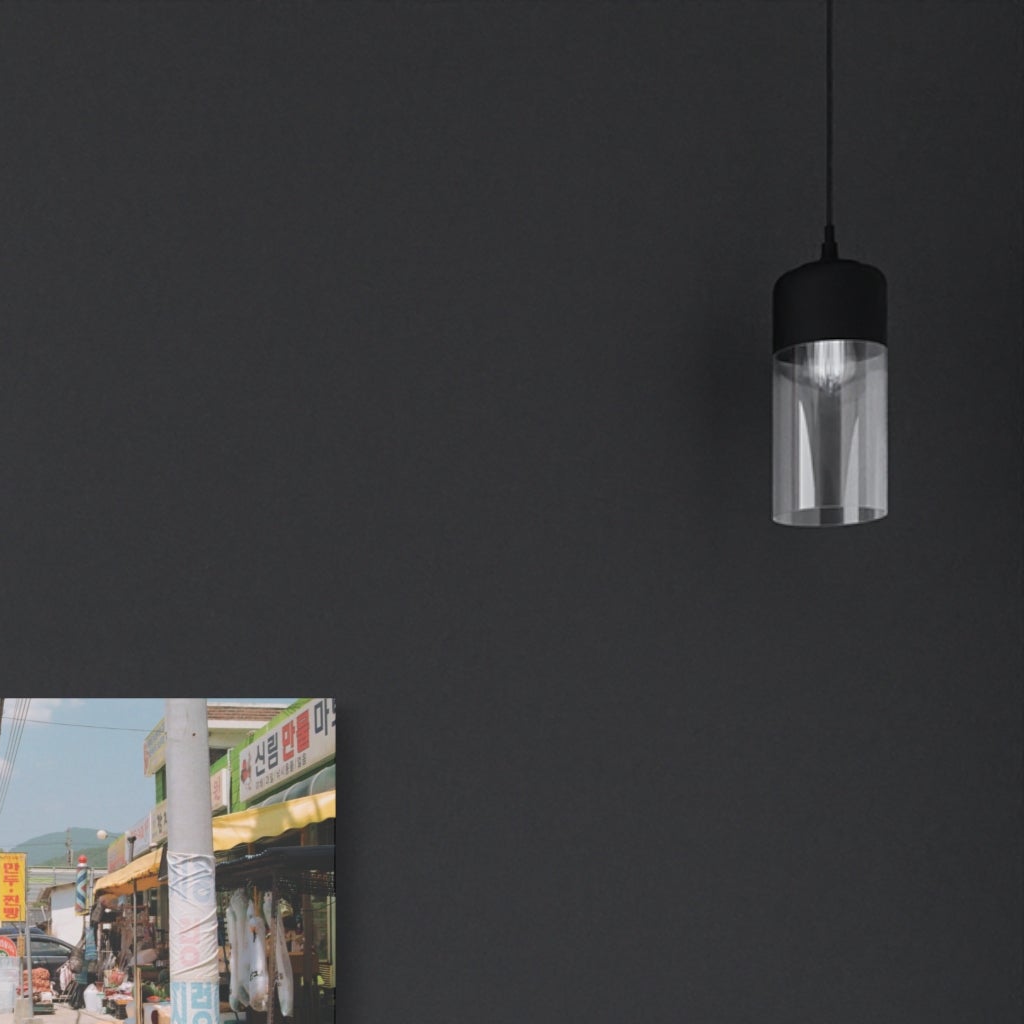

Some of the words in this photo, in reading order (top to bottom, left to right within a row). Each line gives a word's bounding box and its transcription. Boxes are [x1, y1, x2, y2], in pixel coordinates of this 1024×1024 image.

[255, 732, 278, 777] 신림
[282, 709, 310, 762] 만물
[314, 698, 336, 736] 마
